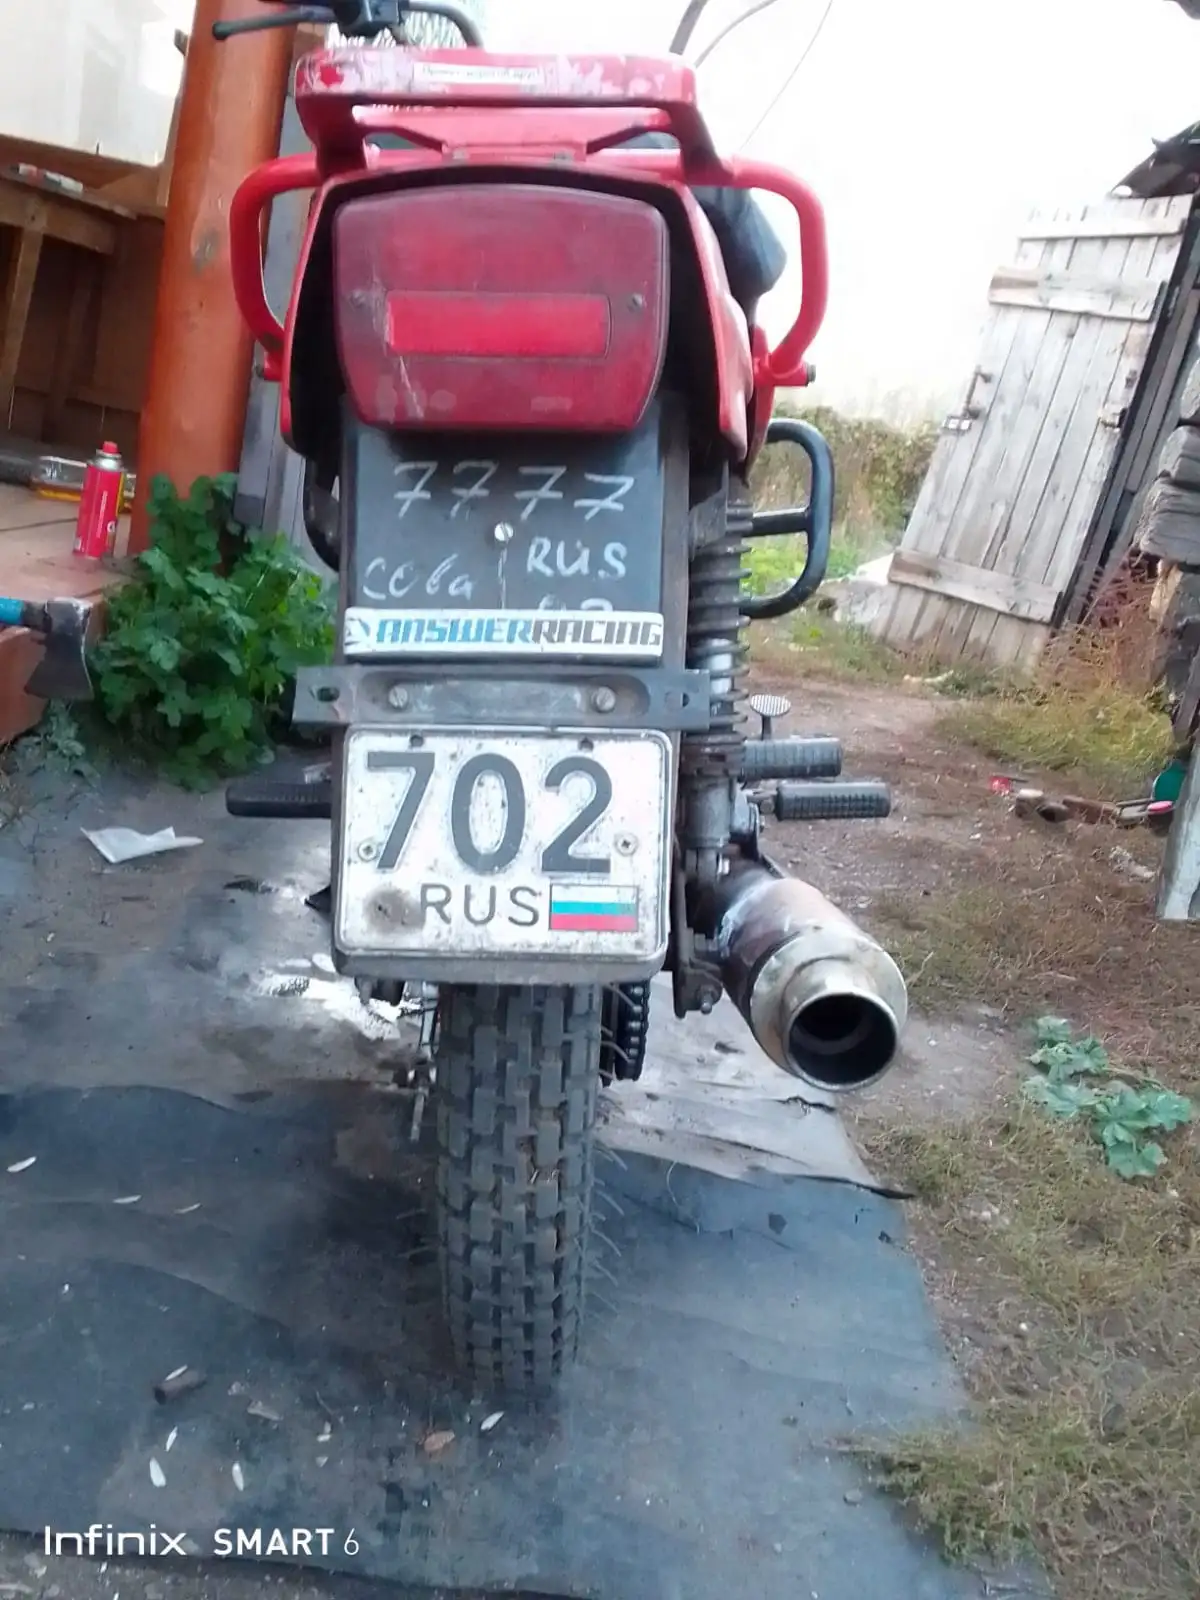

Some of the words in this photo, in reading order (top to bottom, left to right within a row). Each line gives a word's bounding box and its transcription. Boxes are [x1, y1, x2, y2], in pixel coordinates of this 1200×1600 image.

[393, 460, 635, 521] 7777
[526, 536, 628, 578] RUS
[366, 750, 613, 875] 702
[420, 883, 540, 927] RUS
